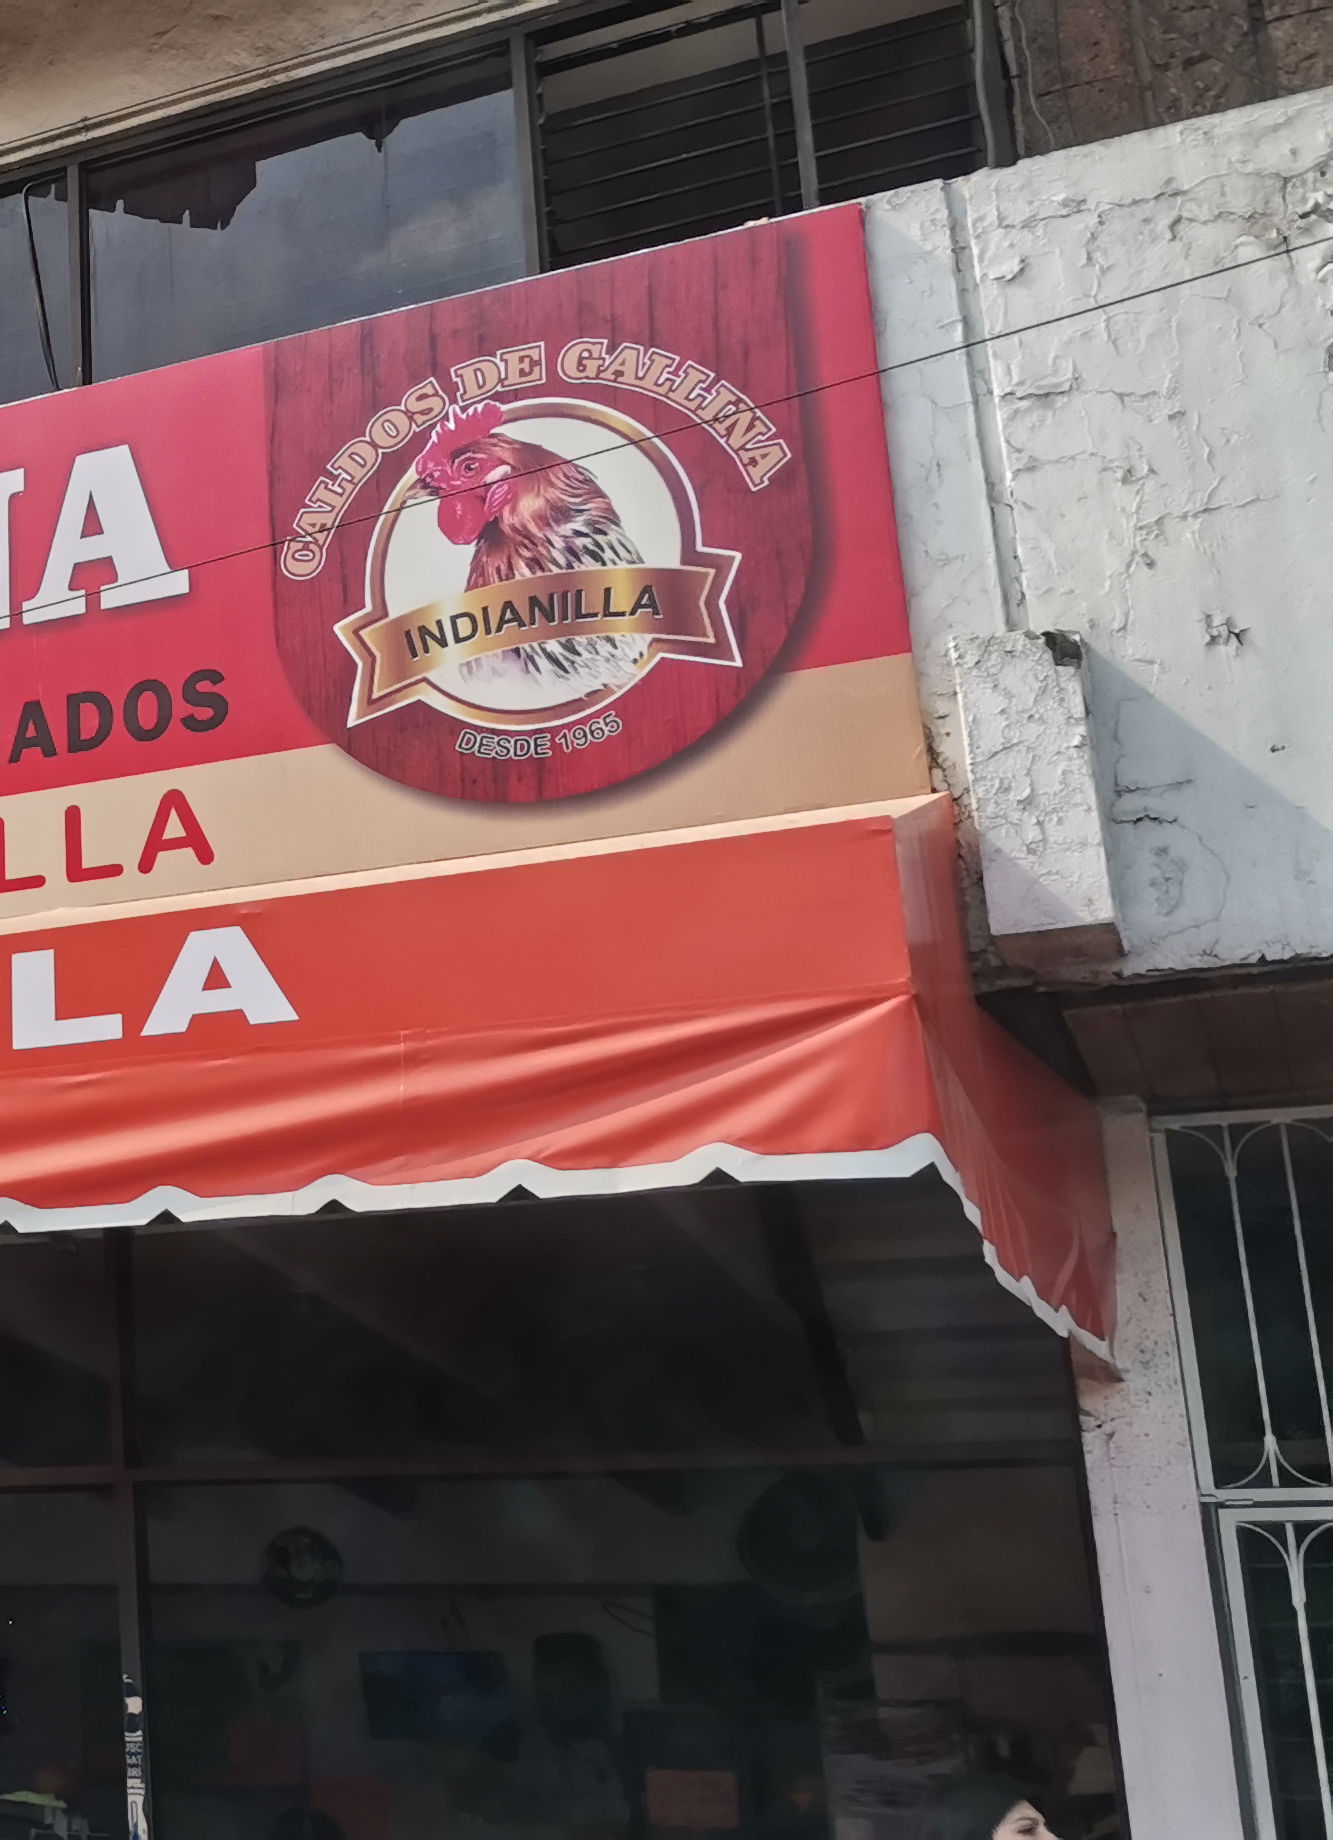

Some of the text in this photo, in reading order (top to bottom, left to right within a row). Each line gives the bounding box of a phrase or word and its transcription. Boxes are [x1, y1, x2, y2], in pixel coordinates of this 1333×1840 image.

[281, 338, 791, 580] CALDOS DE GALLINA
[405, 583, 663, 660] INDIANILLA
[455, 711, 623, 759] DESDE 1965
